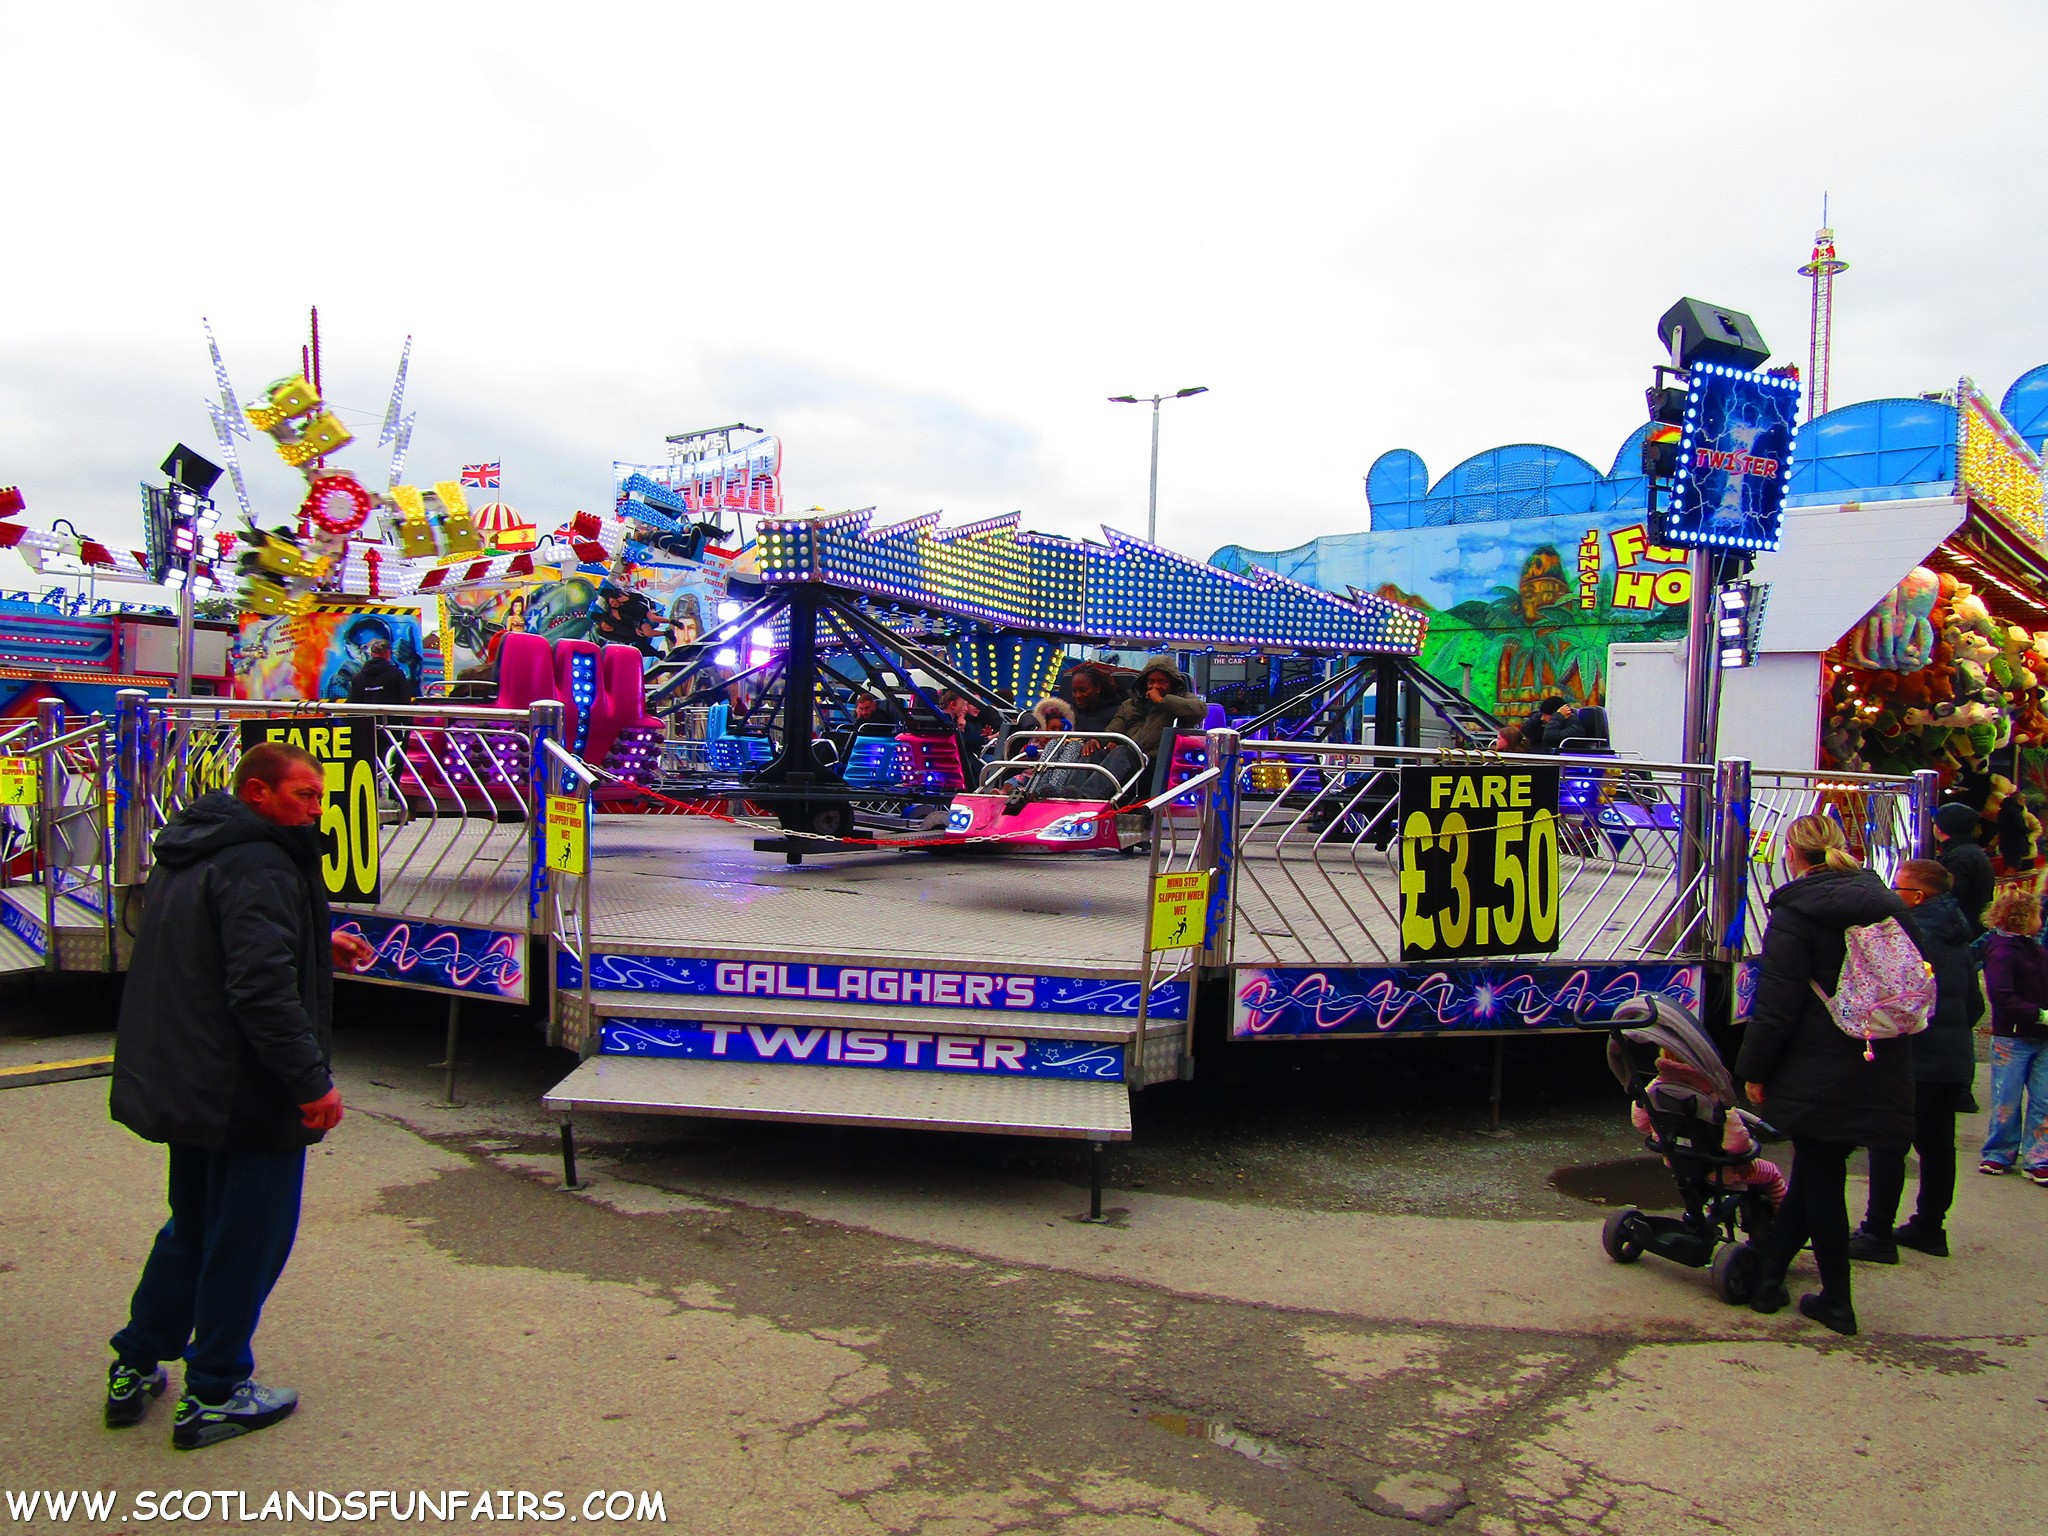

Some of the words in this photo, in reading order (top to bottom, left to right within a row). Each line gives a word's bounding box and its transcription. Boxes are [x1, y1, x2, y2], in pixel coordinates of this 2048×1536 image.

[665, 436, 729, 458] SHAW'S
[1696, 447, 1779, 478] TWISTER
[1577, 529, 1600, 610] JUNGLE
[1430, 775, 1532, 809] FARE
[1104, 819, 1110, 835] 7
[1167, 878, 1183, 888] MIND
[1184, 877, 1199, 887] STEP
[1400, 808, 1558, 951] £3.50
[1158, 891, 1187, 903] SLIPPERY
[1187, 890, 1205, 900] WHEN
[1174, 905, 1188, 916] WET
[715, 962, 1037, 1008] GALLAGHER'S
[701, 1022, 1028, 1072] TWISTER
